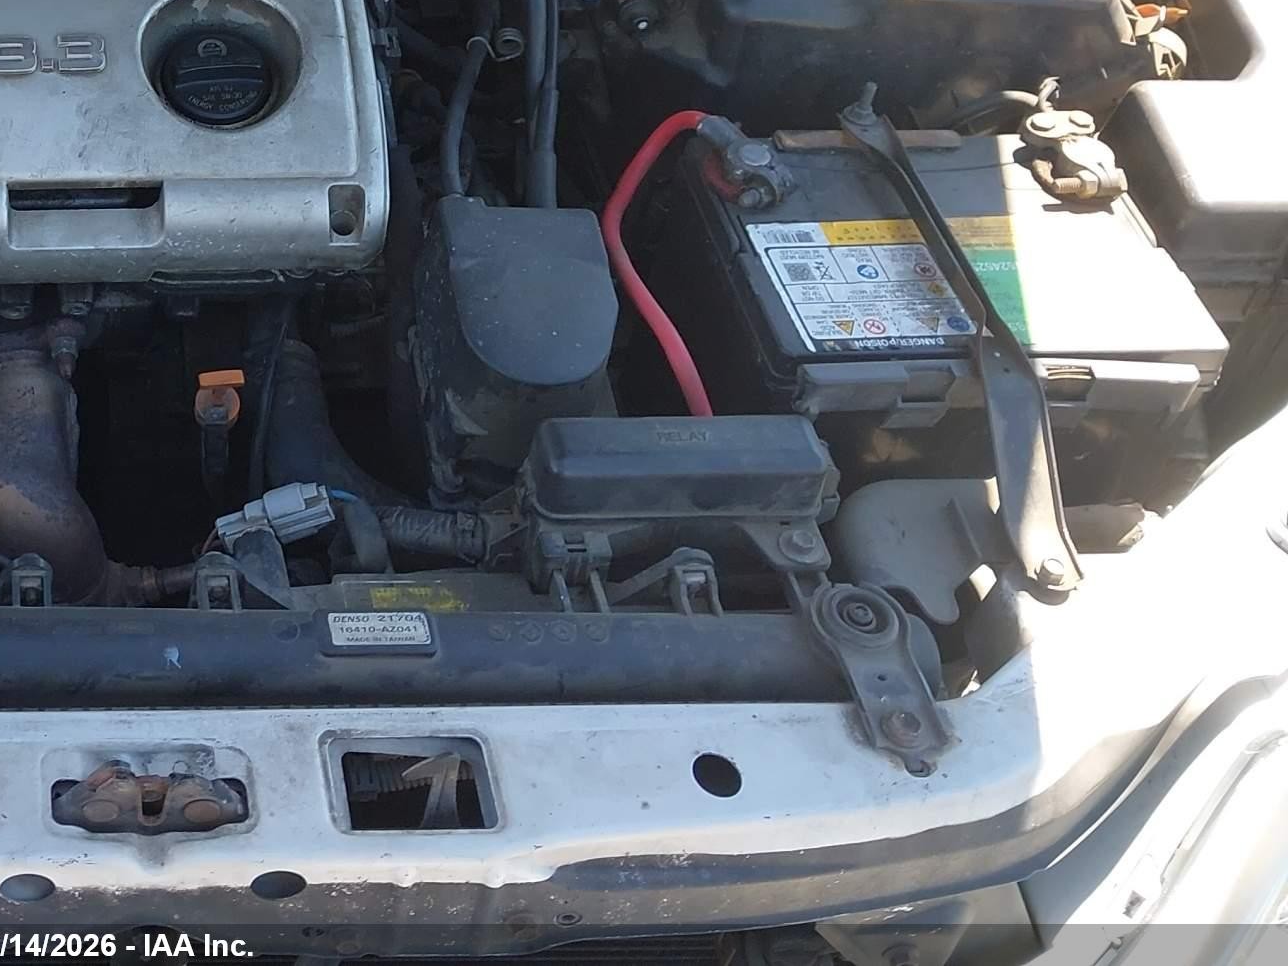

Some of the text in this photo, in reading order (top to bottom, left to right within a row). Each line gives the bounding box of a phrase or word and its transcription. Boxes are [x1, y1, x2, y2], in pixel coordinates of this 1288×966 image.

[655, 429, 710, 443] RELAY
[332, 615, 370, 623] DENSO
[339, 625, 418, 634] 16410-AZ041
